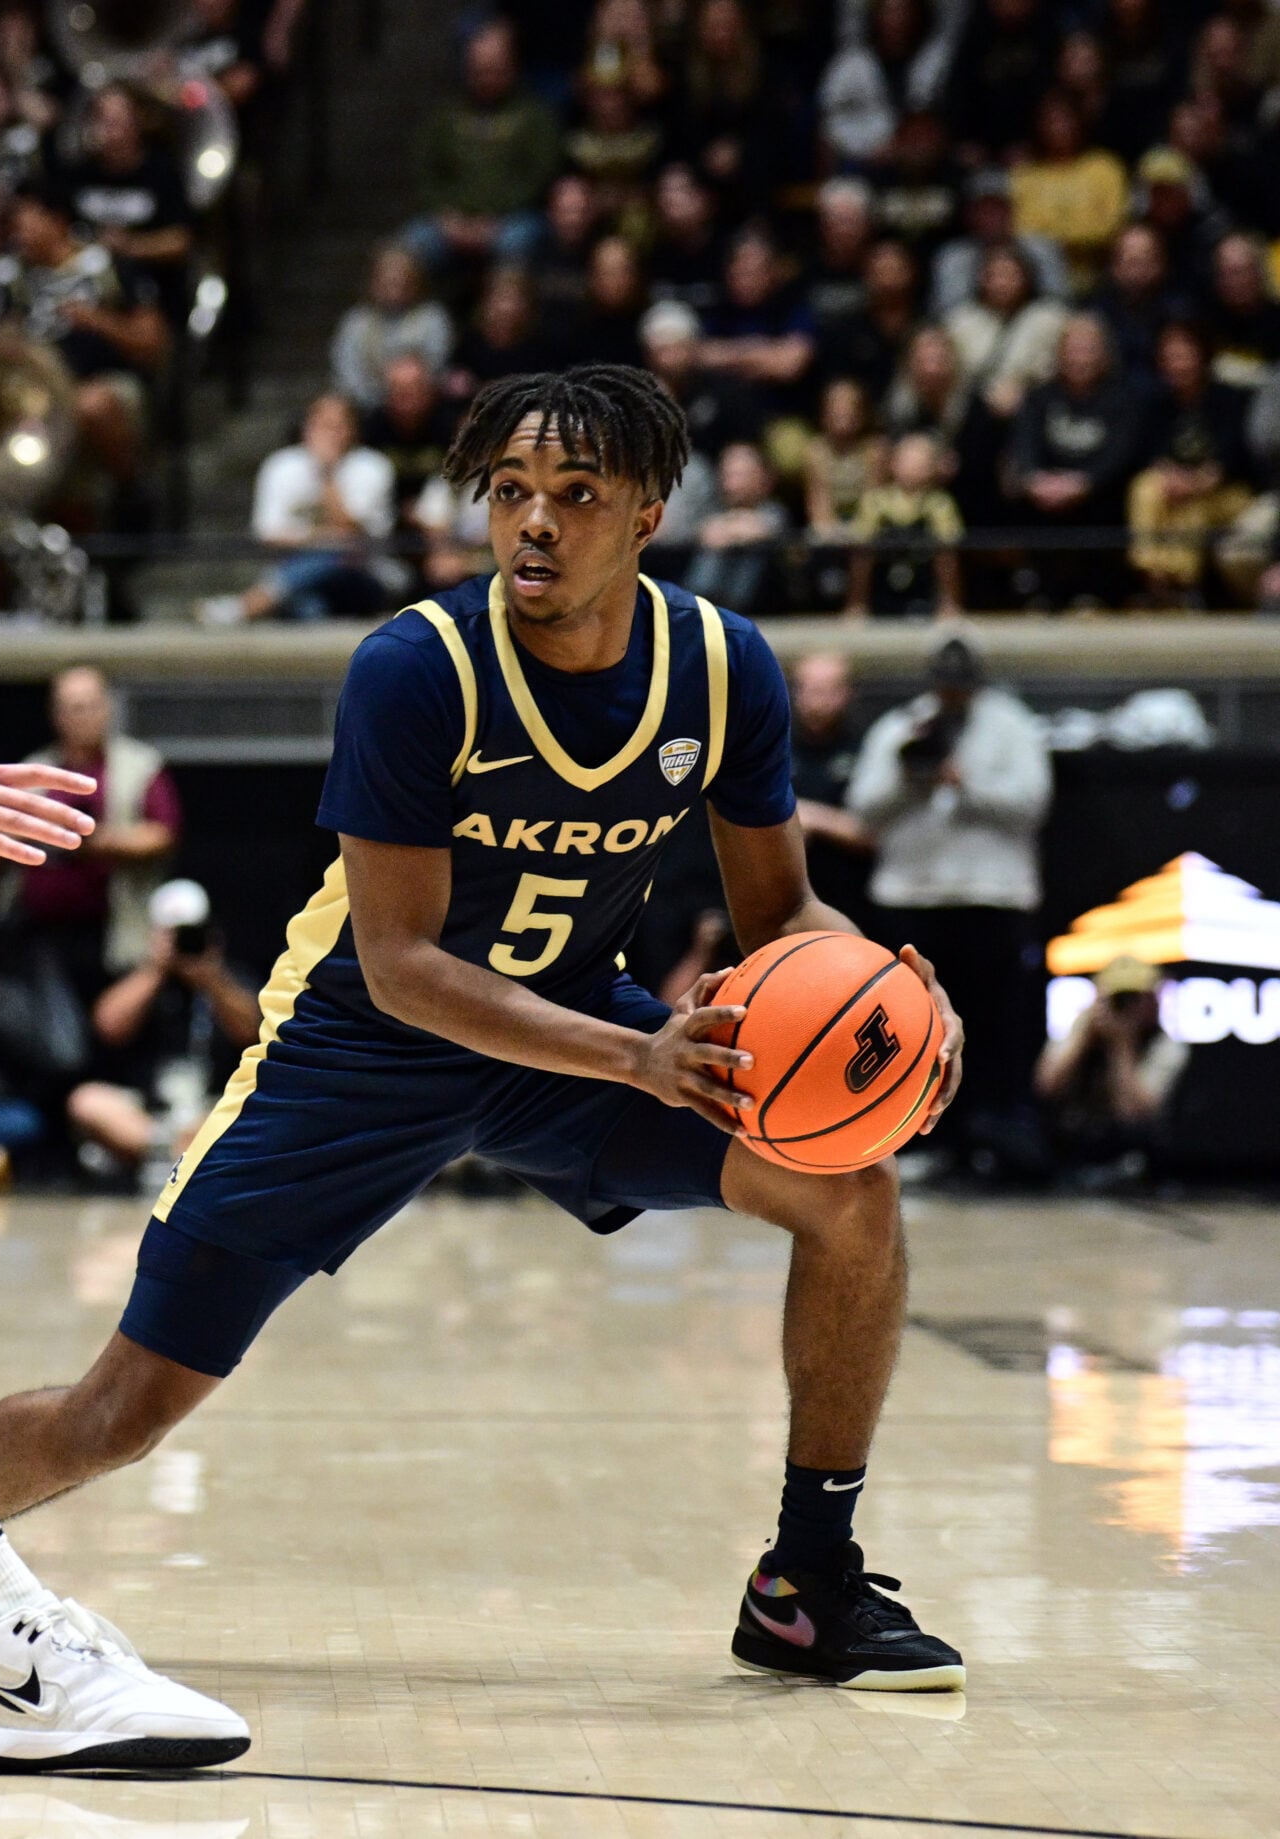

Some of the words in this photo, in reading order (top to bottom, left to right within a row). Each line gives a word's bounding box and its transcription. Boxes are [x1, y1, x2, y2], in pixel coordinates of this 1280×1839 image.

[662, 752, 697, 768] MAC
[452, 807, 690, 855] AKRON
[488, 872, 589, 977] 5
[844, 1003, 901, 1095] P
